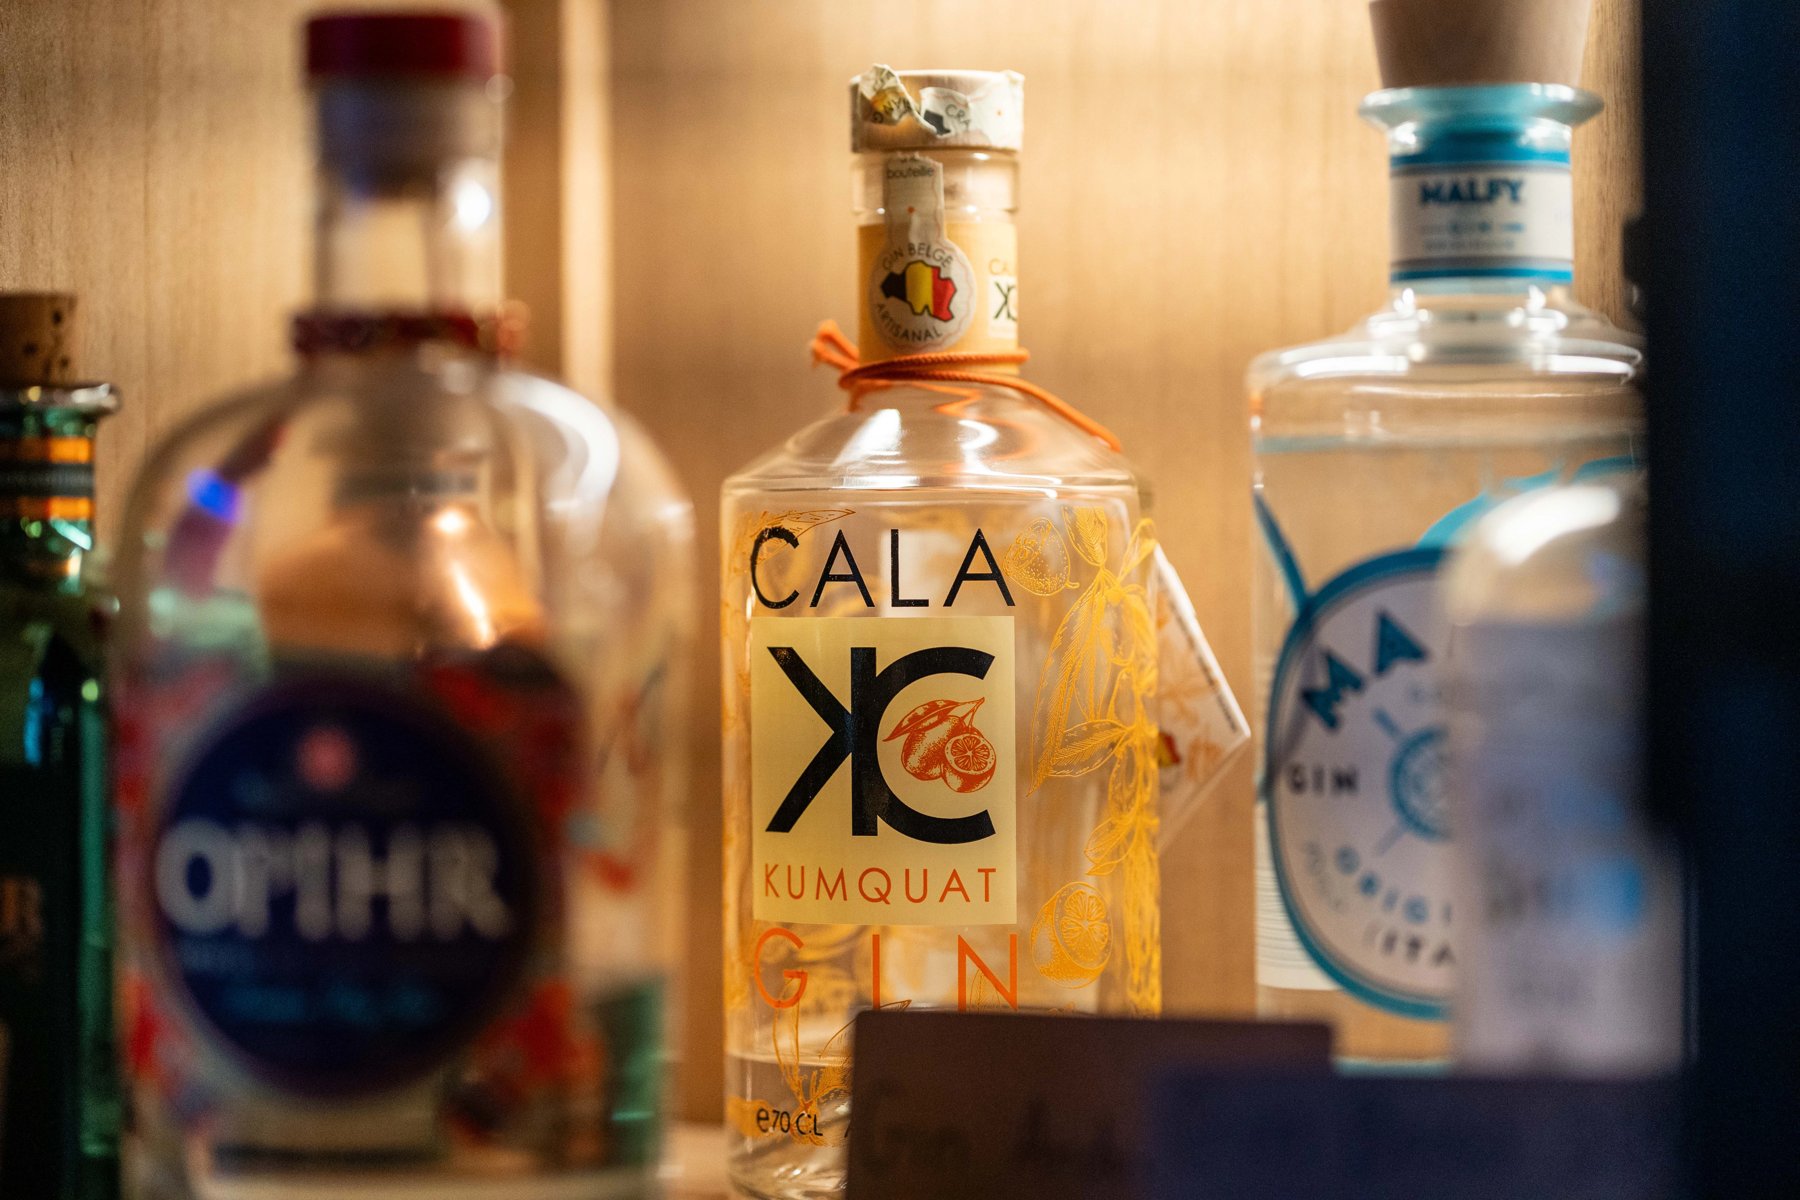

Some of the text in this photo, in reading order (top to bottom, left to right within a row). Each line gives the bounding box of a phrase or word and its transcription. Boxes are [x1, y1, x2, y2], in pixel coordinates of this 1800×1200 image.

[1419, 176, 1525, 206] MALFY
[882, 242, 954, 271] GIN BELGE
[877, 303, 943, 342] ARTISANAL
[750, 526, 1016, 609] CALA
[1302, 608, 1432, 732] MA
[1286, 761, 1360, 797] GIN
[764, 863, 997, 905] KUMQUAT
[754, 927, 1018, 1012] GIN
